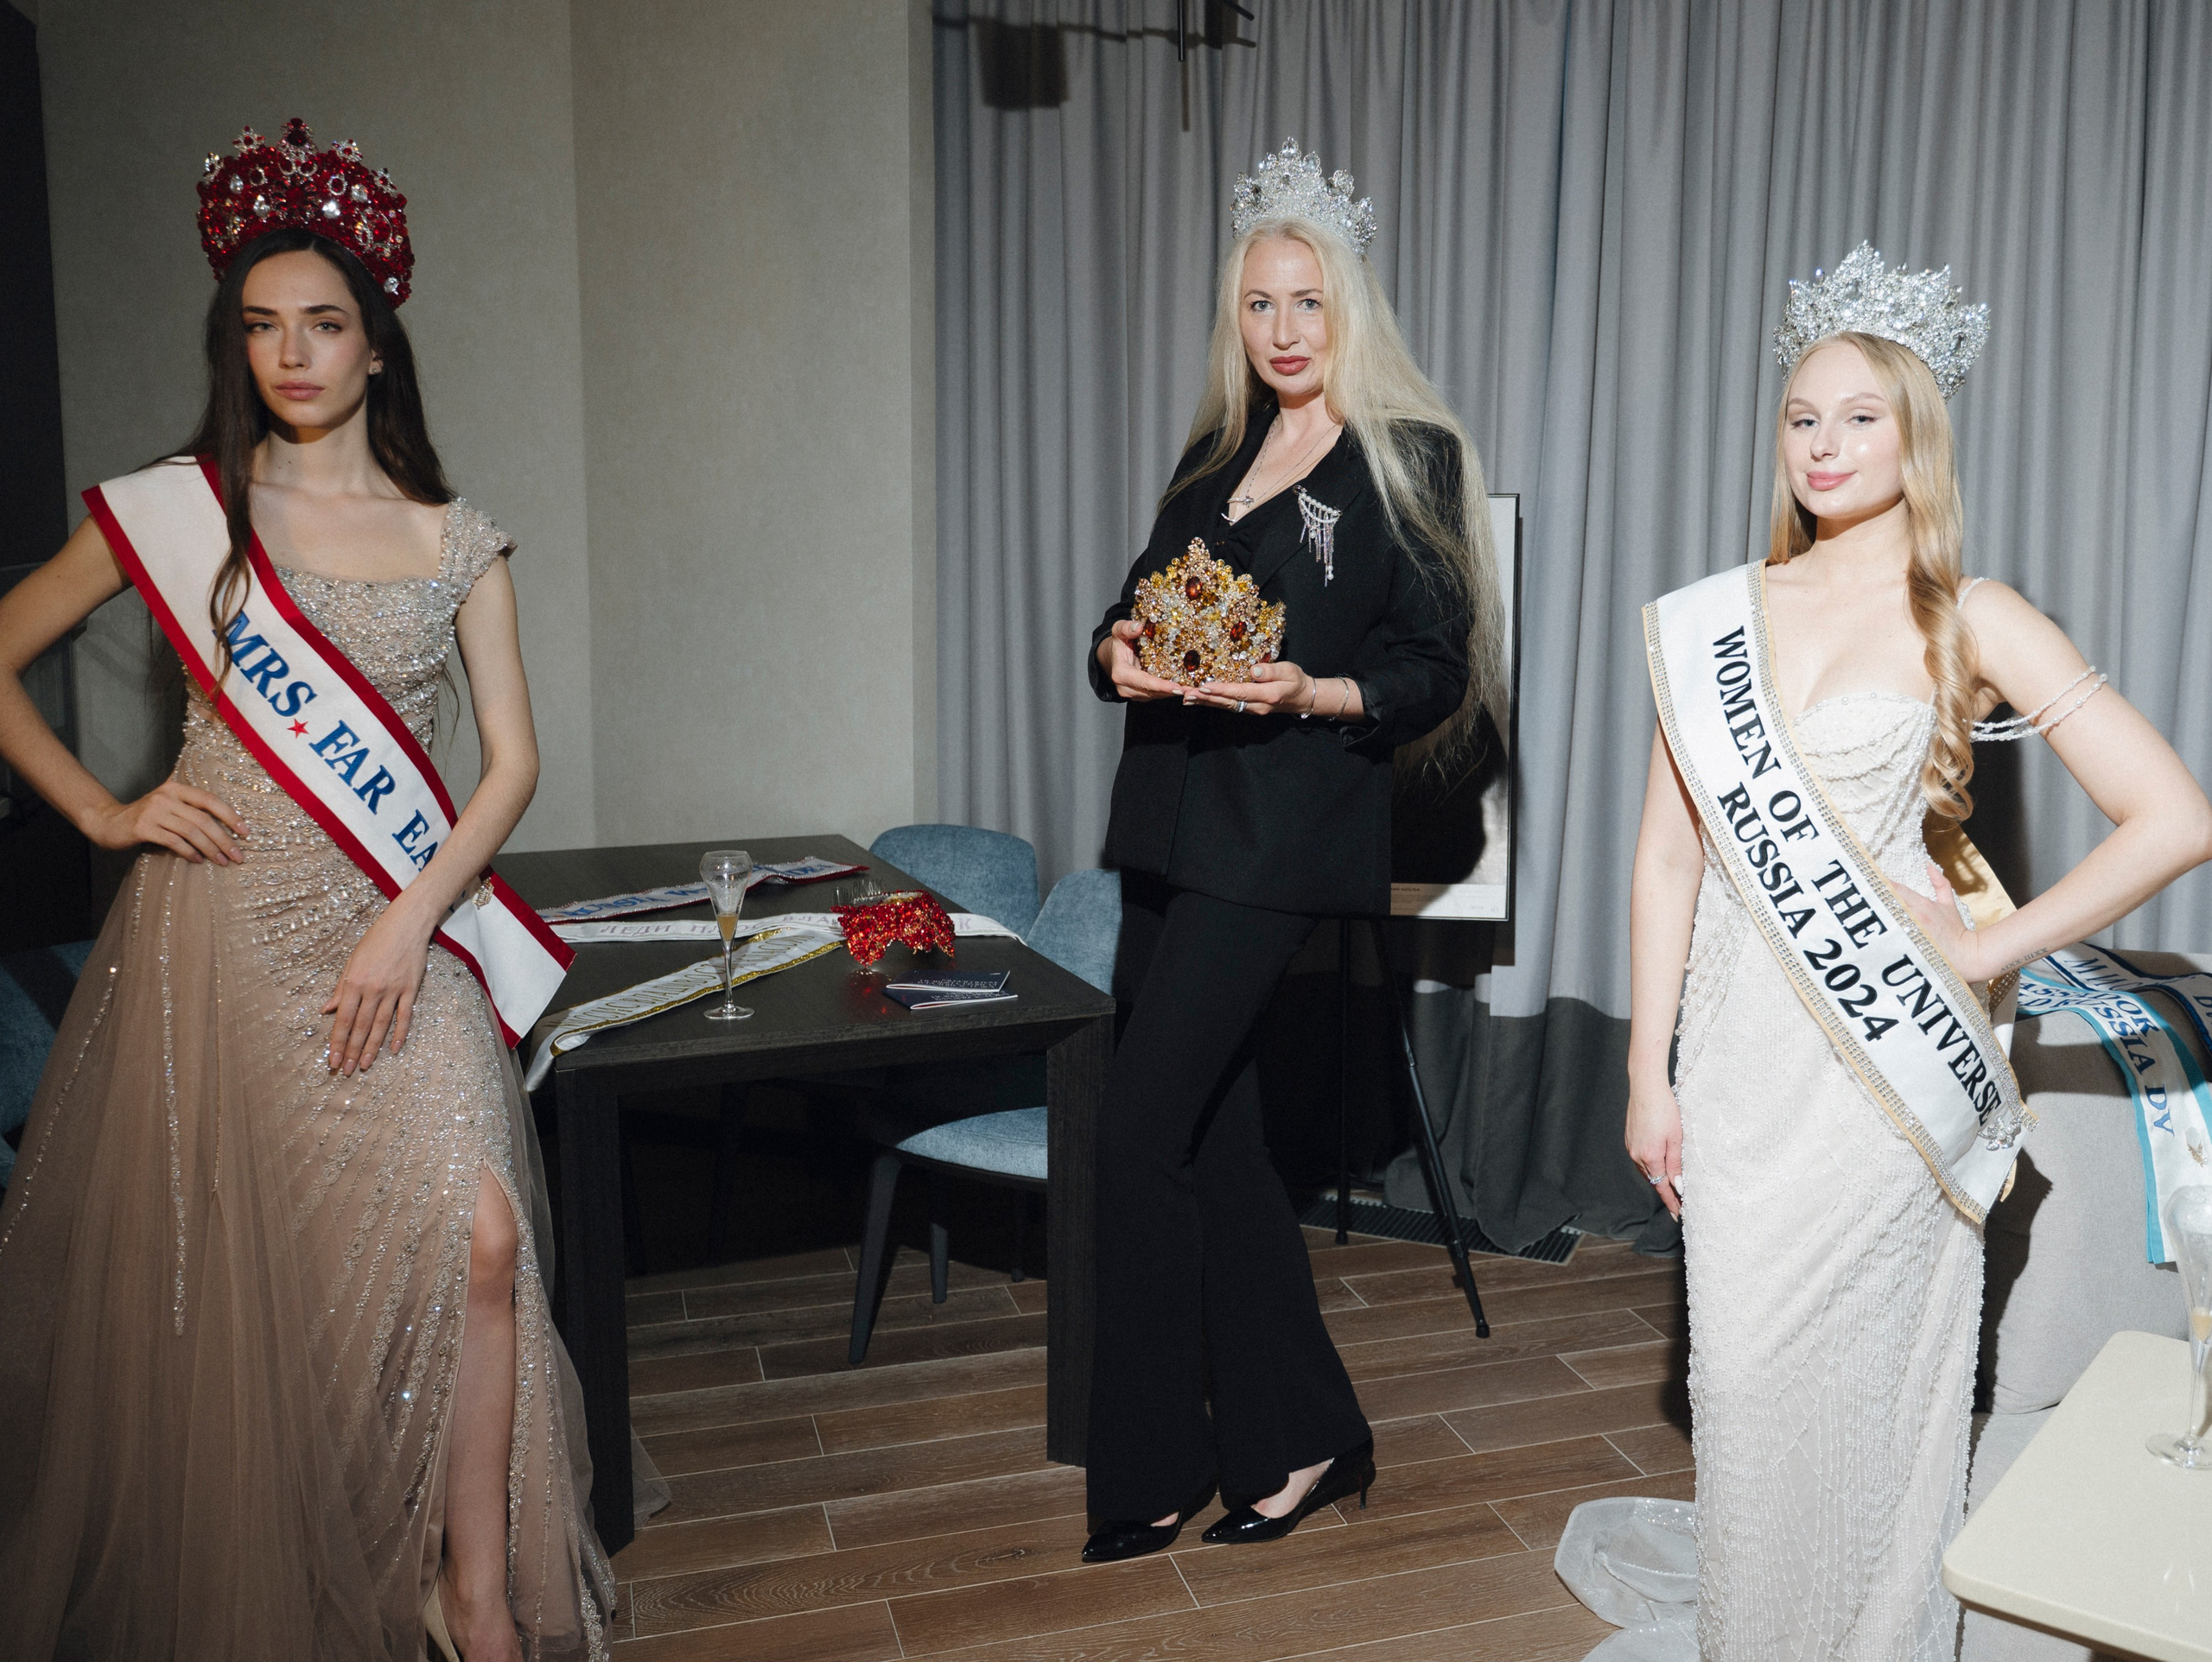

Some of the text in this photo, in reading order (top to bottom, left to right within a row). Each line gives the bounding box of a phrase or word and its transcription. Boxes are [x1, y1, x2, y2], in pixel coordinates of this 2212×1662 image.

[212, 609, 319, 718] MRS
[308, 720, 397, 815] FAR
[600, 924, 671, 936] ЛЕДИ
[1712, 625, 2003, 1127] WOMEN OF THE UNIVERSE
[1716, 781, 1901, 1044] RUSSIA 2024
[2144, 1083, 2176, 1138] DV
